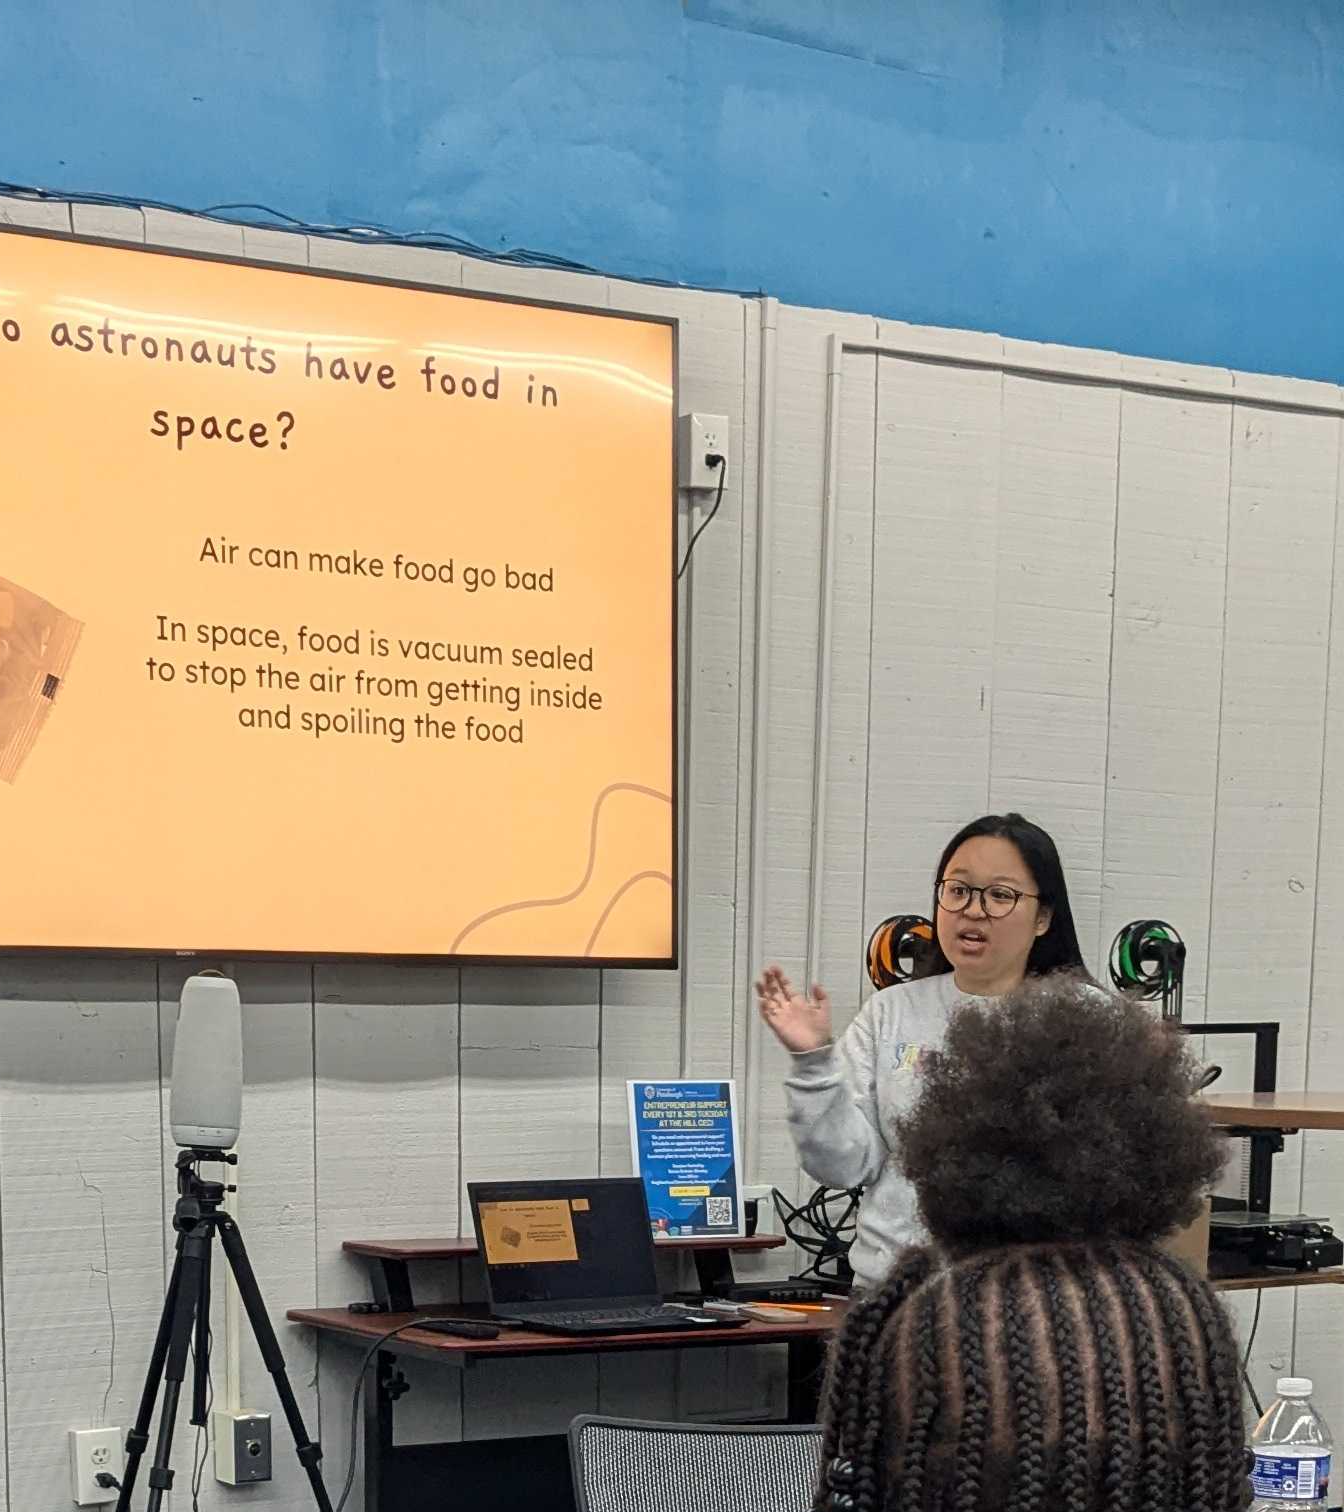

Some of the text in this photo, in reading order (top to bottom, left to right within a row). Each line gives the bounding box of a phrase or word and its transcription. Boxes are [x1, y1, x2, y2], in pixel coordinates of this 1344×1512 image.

[50, 318, 277, 374] astronauts
[305, 342, 396, 390] have
[420, 356, 499, 400] food
[527, 374, 558, 407] in
[150, 410, 296, 451] space?
[199, 537, 553, 593] Air can make food go bad
[156, 615, 593, 672] In space, food is vacuum sealed
[145, 657, 603, 712] to stop the air from getting inside
[238, 703, 523, 744] and spoiling the food
